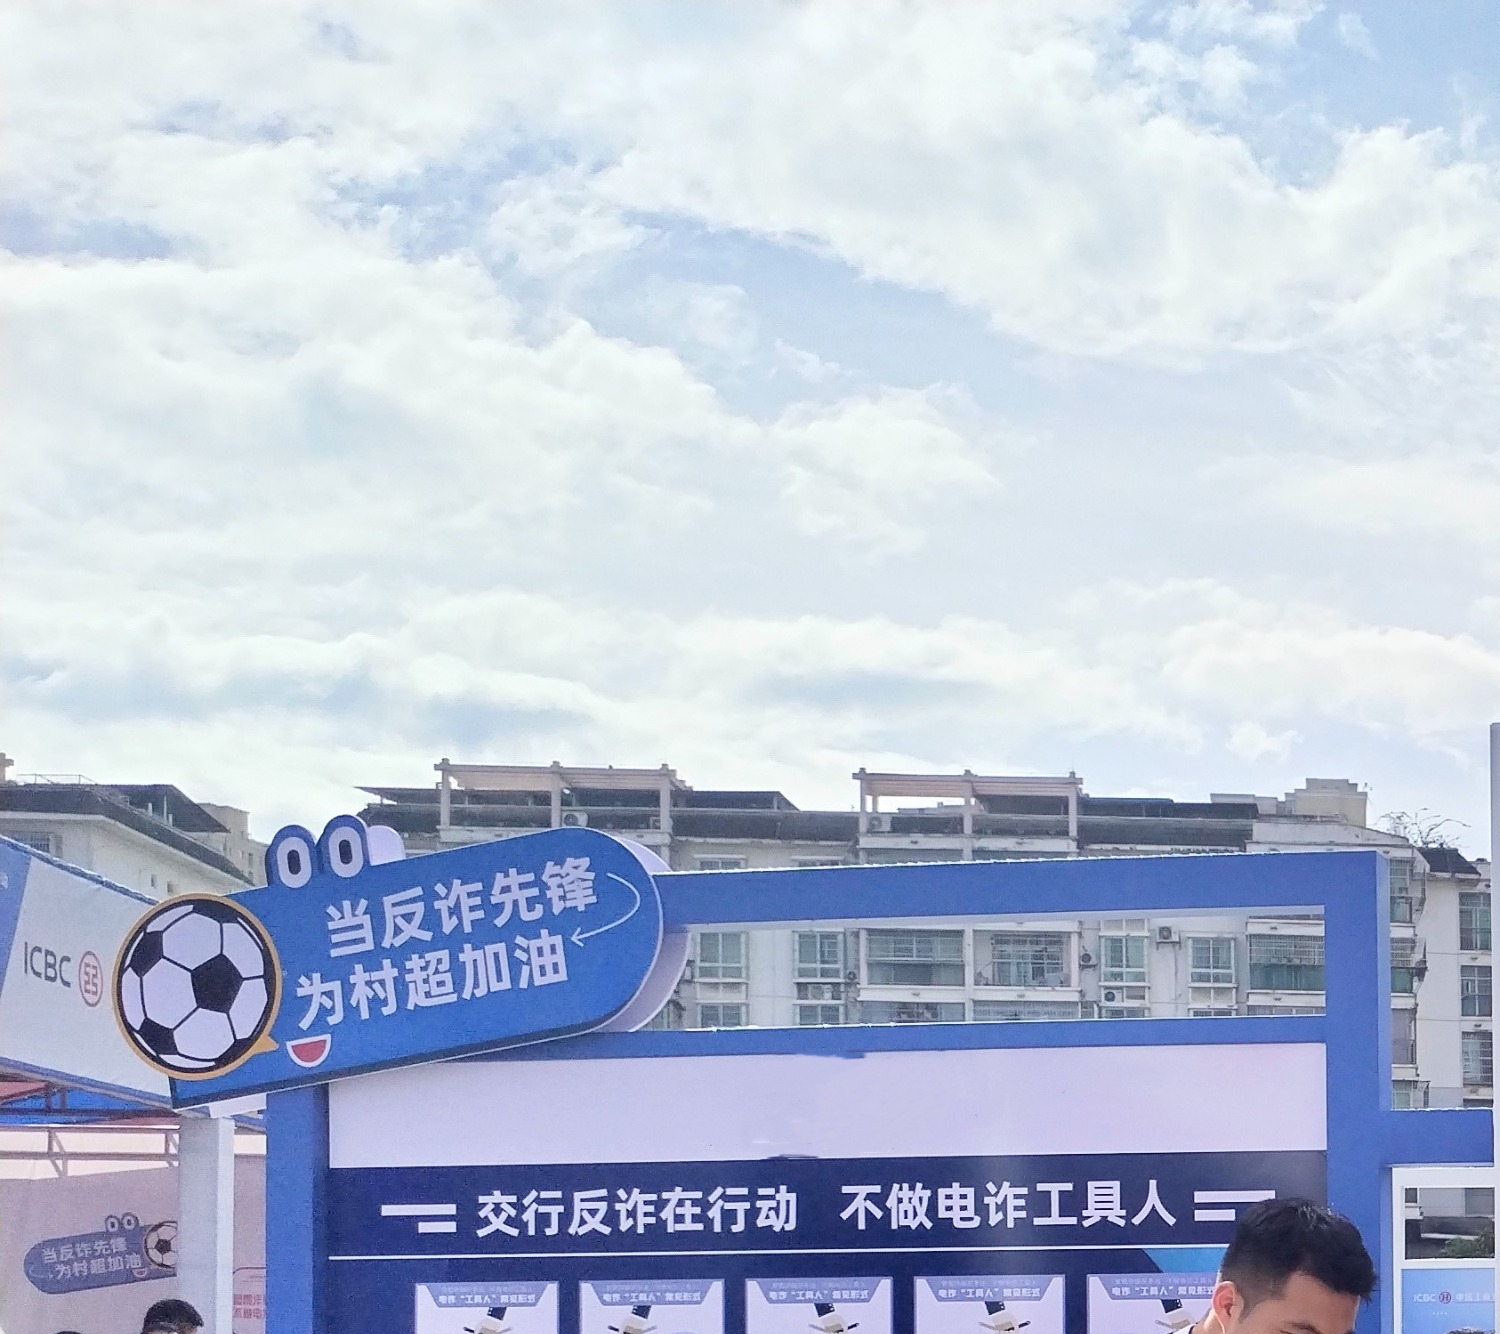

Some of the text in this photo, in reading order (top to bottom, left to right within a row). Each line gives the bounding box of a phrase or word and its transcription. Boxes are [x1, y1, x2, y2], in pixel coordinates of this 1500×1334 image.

[325, 854, 598, 959] 当反诈先锋
[23, 941, 72, 989] ICBC
[295, 929, 570, 1031] 为村超加油
[476, 1179, 1177, 1237] 交行反诈在行动 不做电诈工具人
